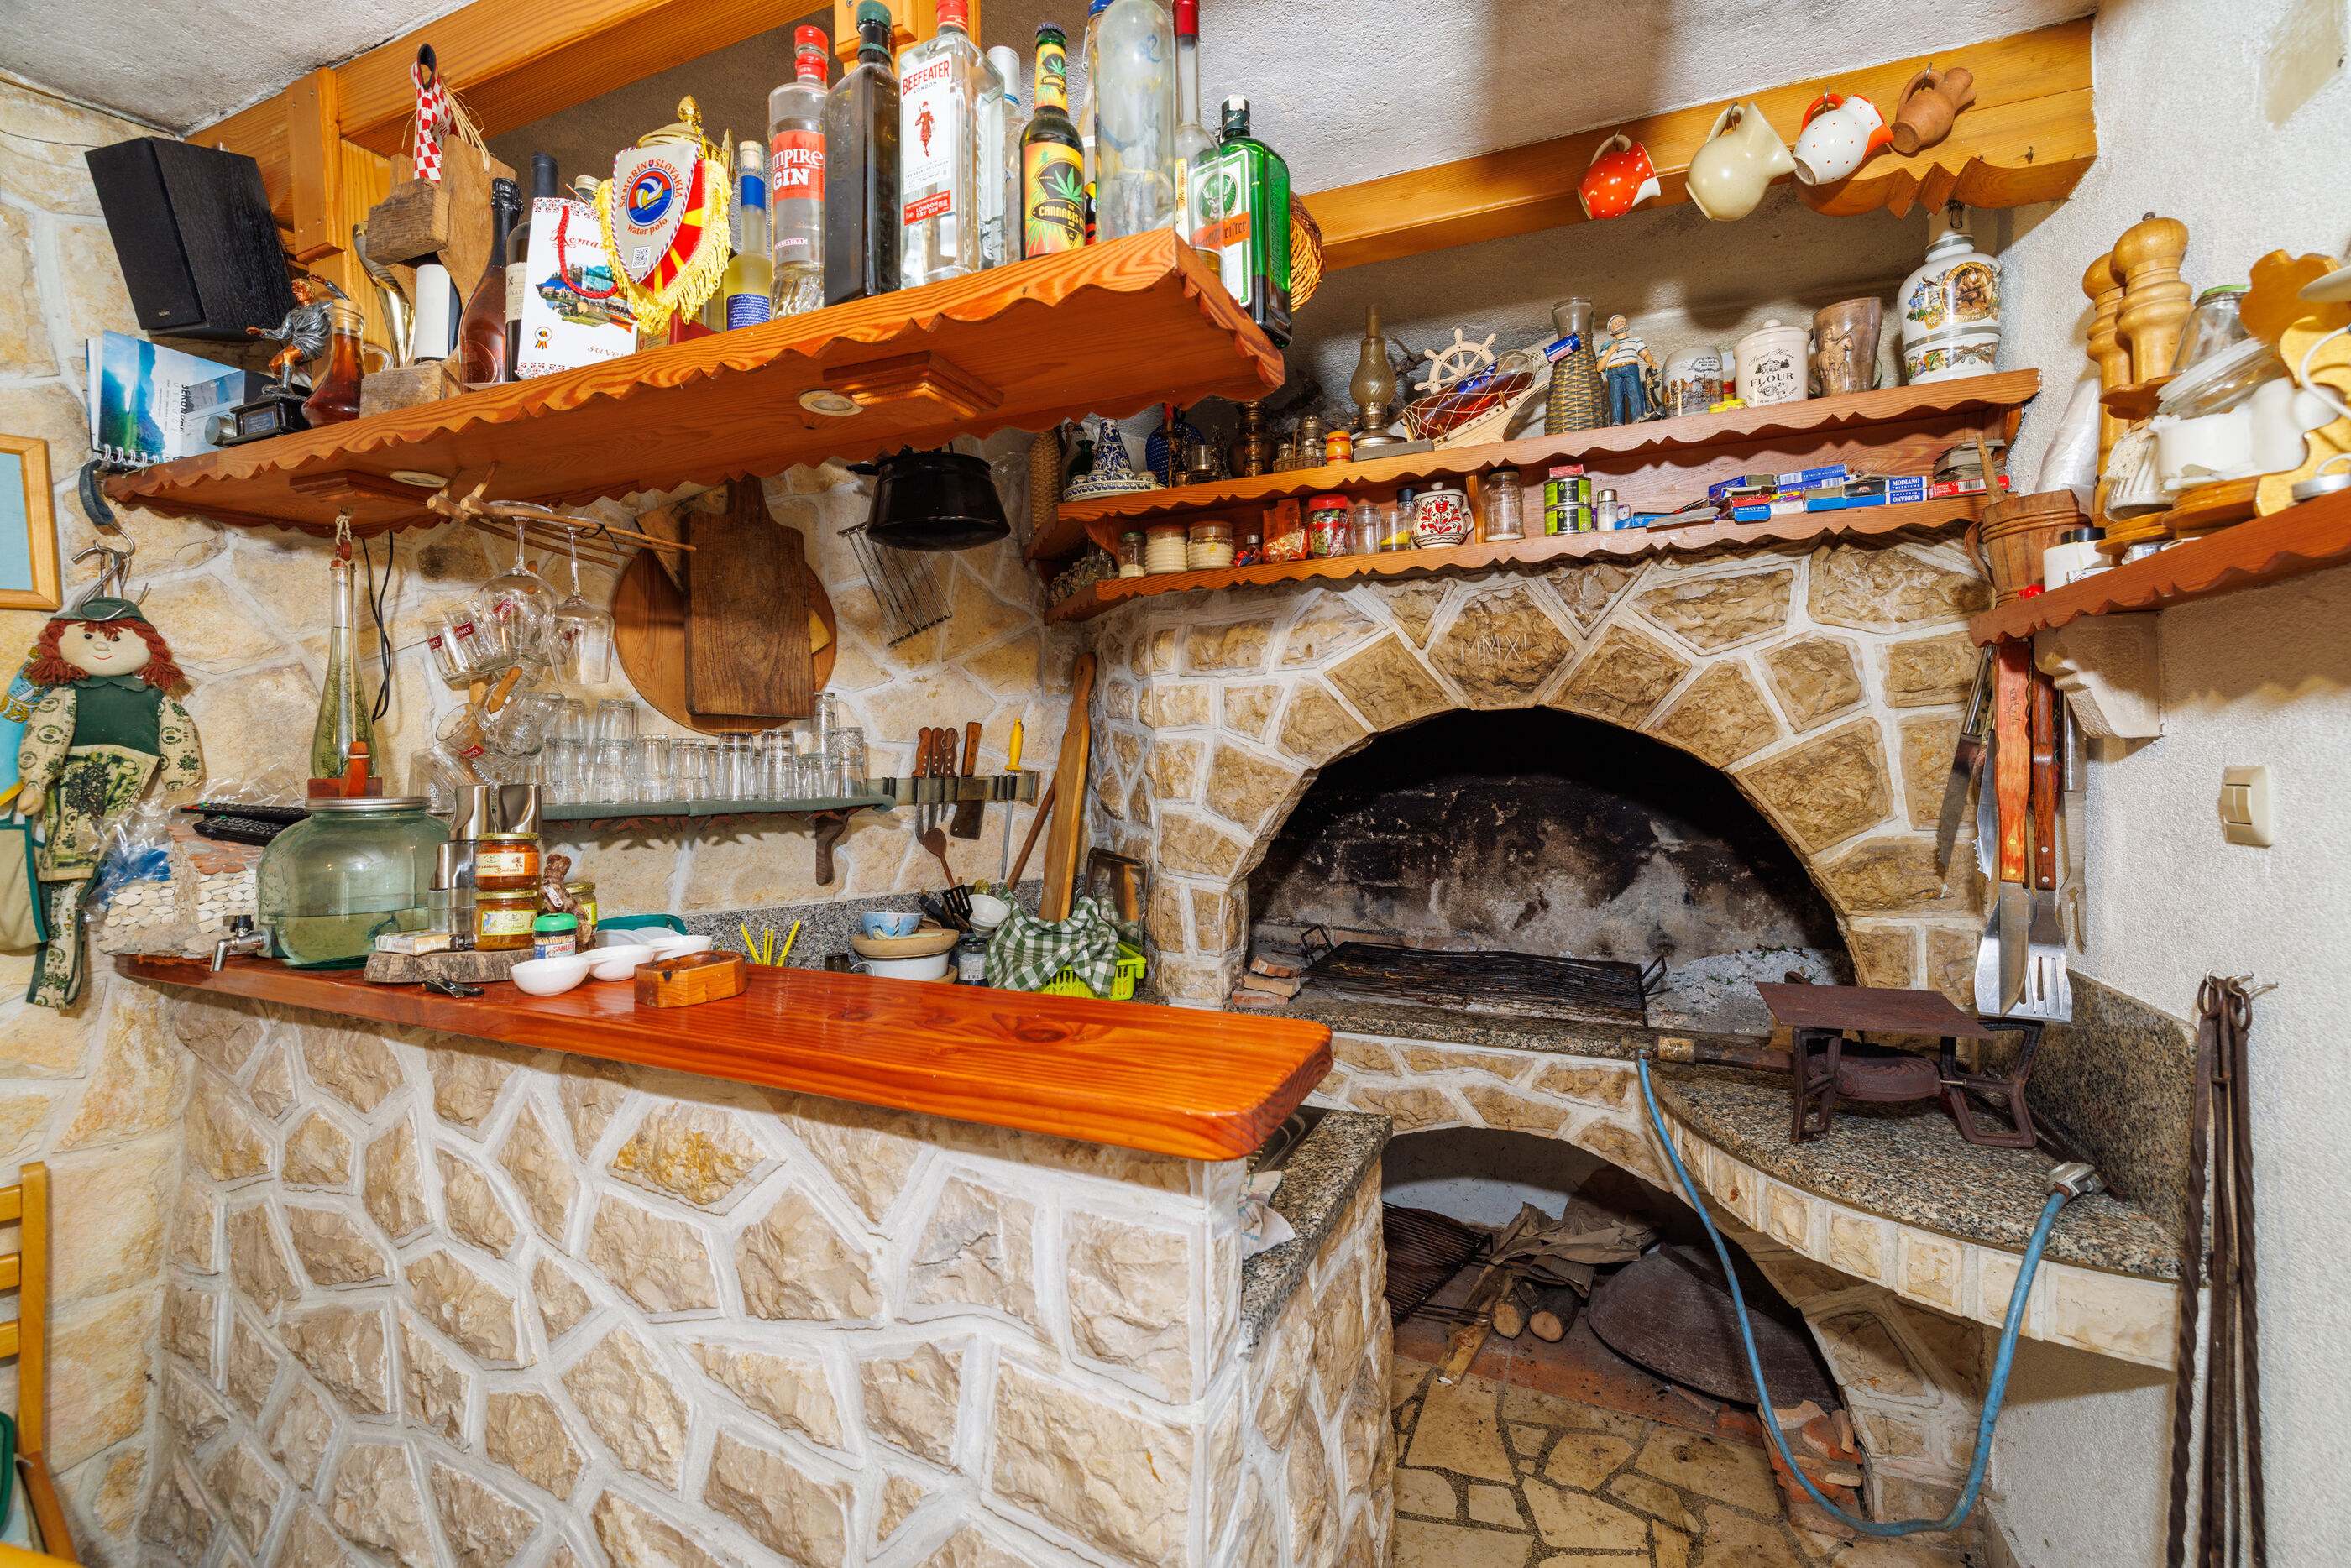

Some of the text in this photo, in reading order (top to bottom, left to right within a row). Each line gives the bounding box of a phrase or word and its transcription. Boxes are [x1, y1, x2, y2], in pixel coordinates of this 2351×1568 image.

[903, 60, 950, 97] BEEFEATER
[914, 81, 938, 94] LONDON
[619, 159, 683, 208] ŠAMORÍN SLOVAKIA
[773, 168, 810, 191] GIN
[916, 201, 938, 214] LONDON
[916, 208, 928, 218] DRY
[929, 206, 938, 216] GIN
[1039, 206, 1078, 224] CANNABIS
[627, 218, 668, 236] water polo
[1750, 372, 1794, 388] FLOUR
